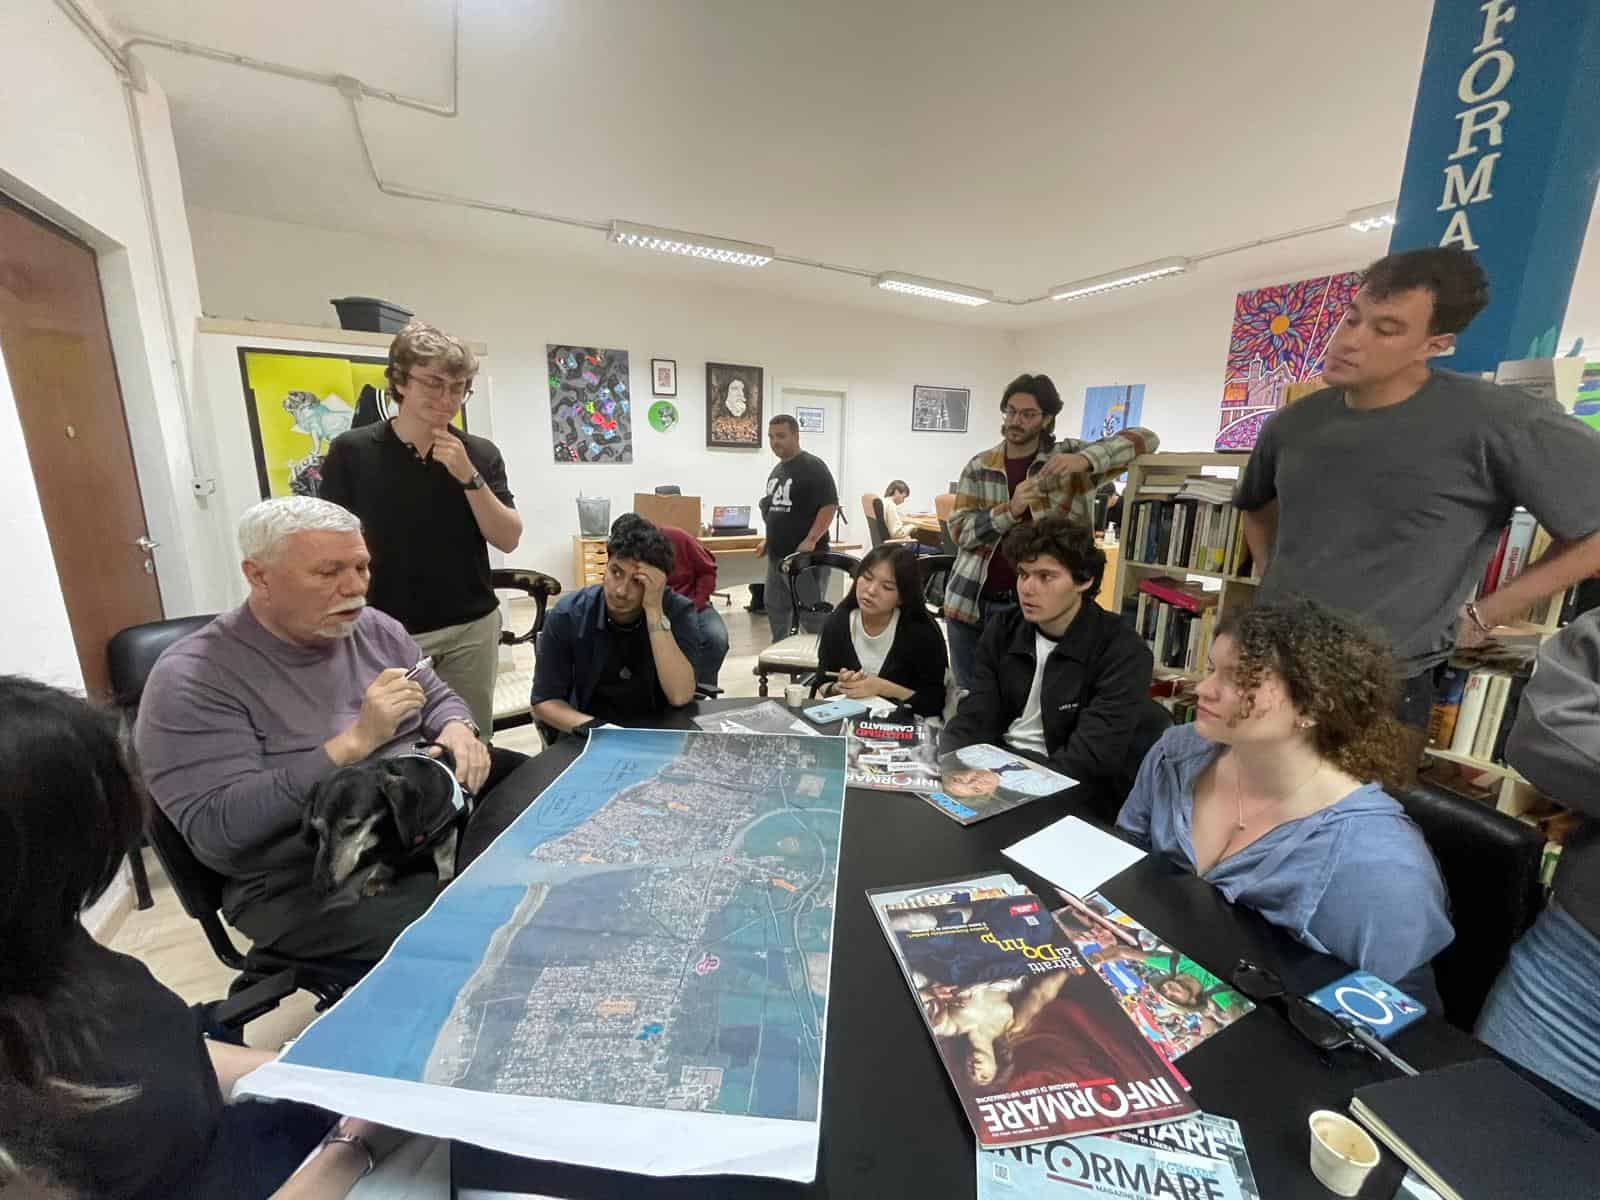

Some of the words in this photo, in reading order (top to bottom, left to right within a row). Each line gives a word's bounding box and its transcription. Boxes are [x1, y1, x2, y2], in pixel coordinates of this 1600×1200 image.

[1027, 957, 1082, 974] Ritratti
[977, 1077, 1181, 1132] INFORMARE
[980, 1140, 1224, 1200] FORMARE
